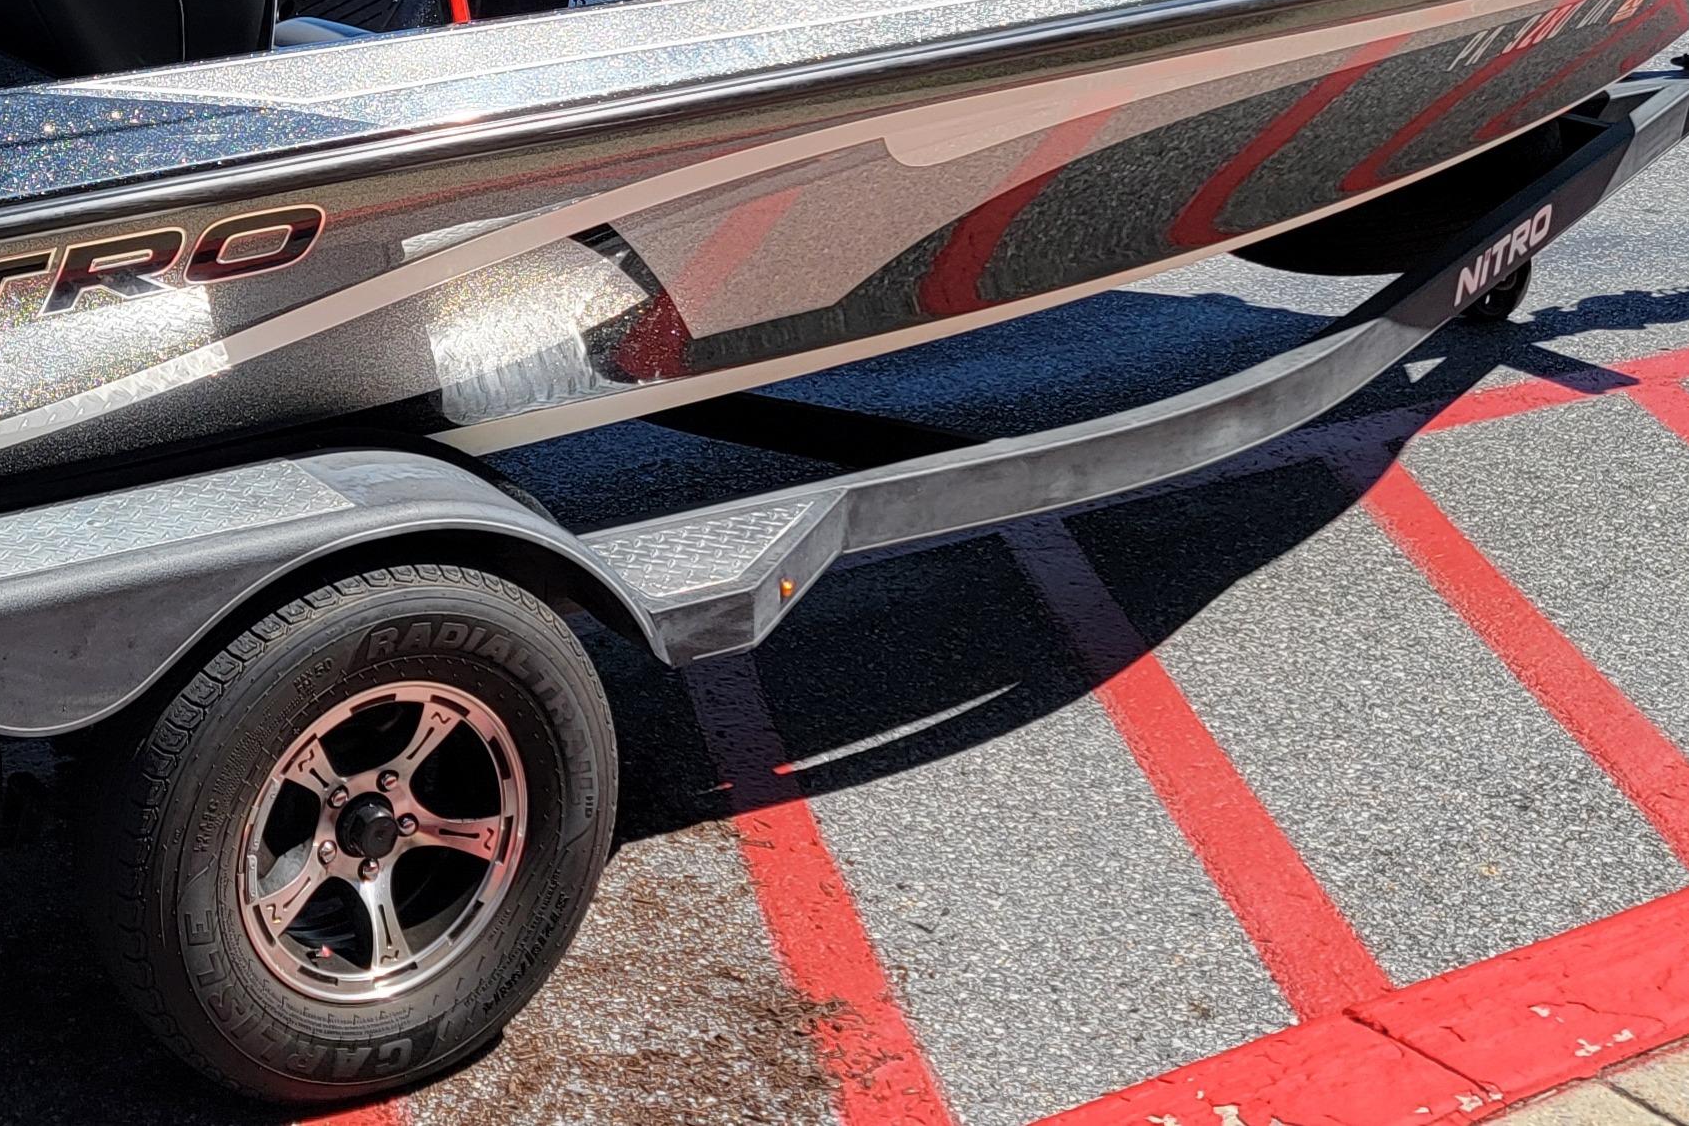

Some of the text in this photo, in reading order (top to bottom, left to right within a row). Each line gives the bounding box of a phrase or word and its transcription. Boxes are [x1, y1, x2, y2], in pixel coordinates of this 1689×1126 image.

[1446, 25, 1506, 72] PA
[1453, 203, 1553, 308] NITRO
[367, 621, 532, 677] RADIAL
[531, 668, 593, 807] TRAIL
[185, 908, 414, 1075] CARLISLE
